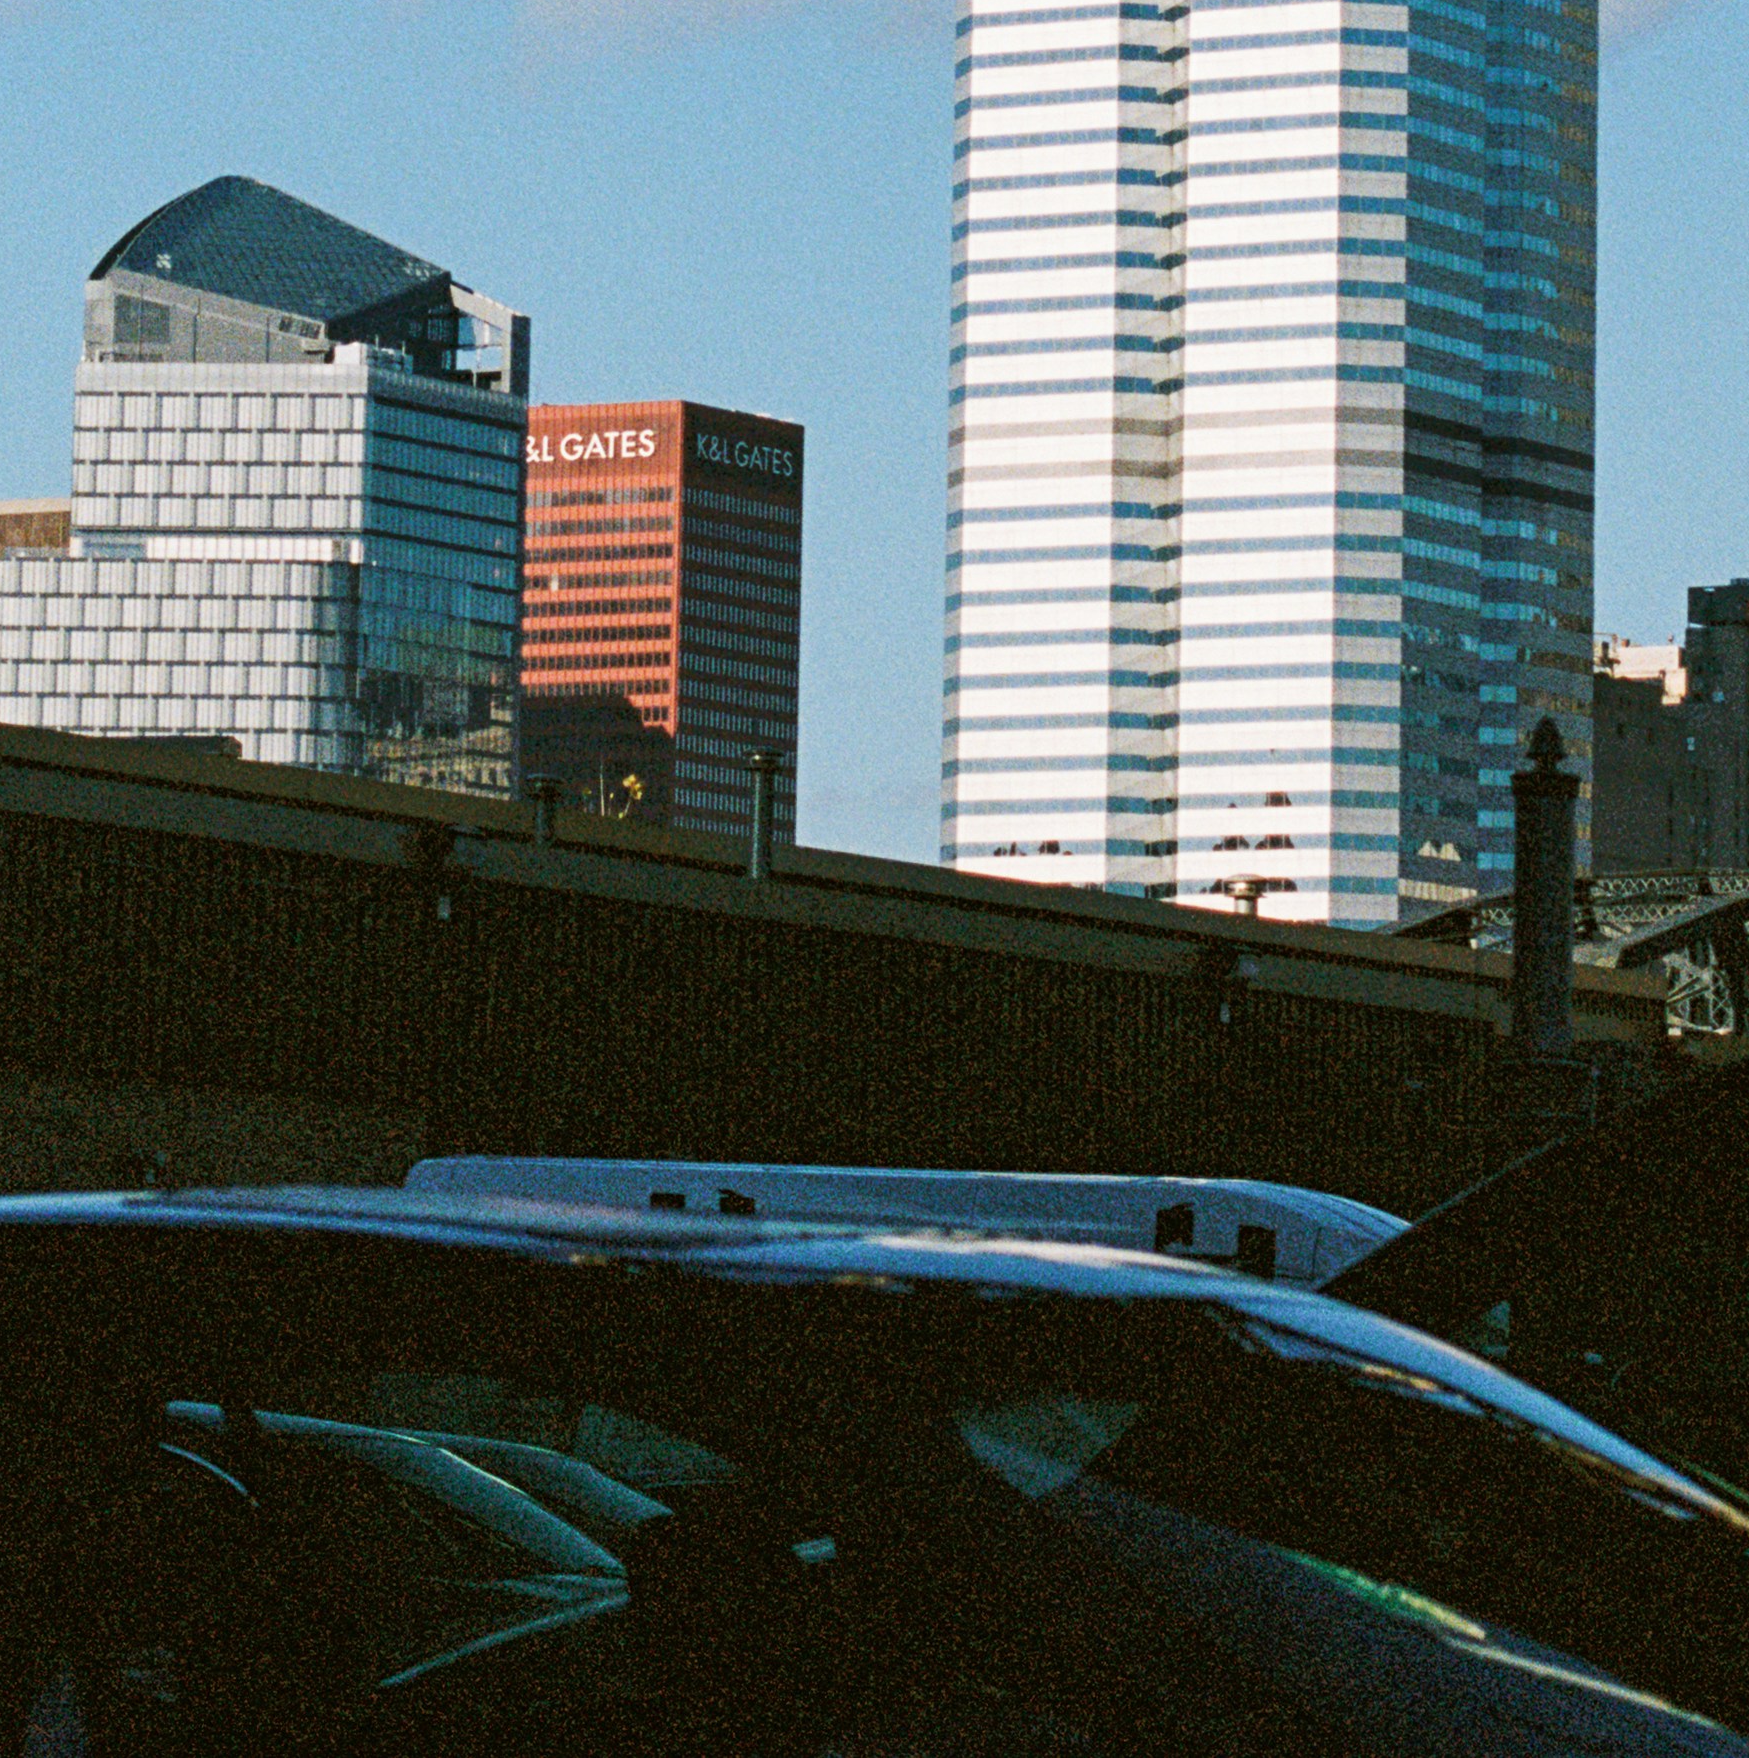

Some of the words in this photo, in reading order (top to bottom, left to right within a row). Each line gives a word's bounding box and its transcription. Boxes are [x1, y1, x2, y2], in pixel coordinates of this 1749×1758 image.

[560, 429, 655, 461] GATES
[696, 433, 730, 464] K&L
[734, 440, 793, 476] GATES
